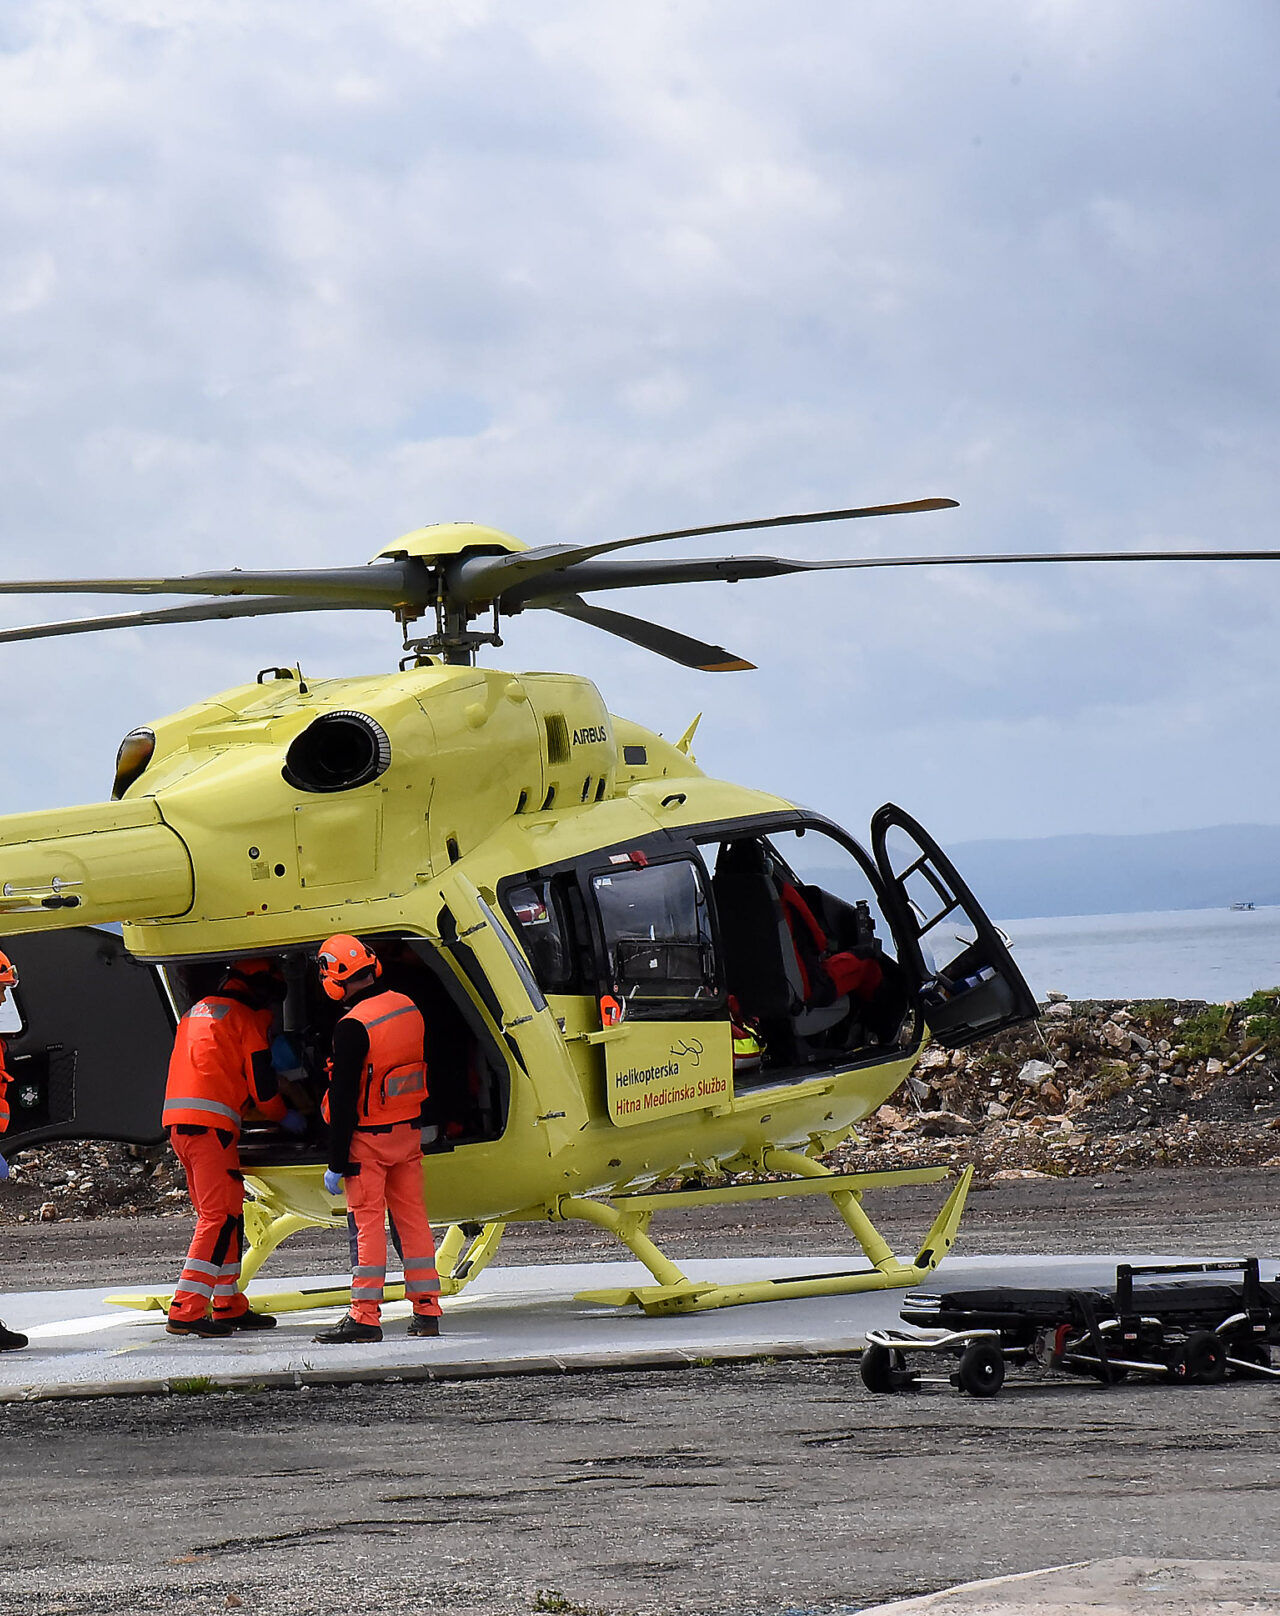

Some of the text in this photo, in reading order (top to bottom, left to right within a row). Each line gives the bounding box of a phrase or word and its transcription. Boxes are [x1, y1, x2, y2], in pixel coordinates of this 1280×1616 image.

[572, 725, 607, 746] AIRBUS
[615, 1060, 679, 1088] Helikopterska
[616, 1076, 727, 1116] Hitna Medicinska Služba
